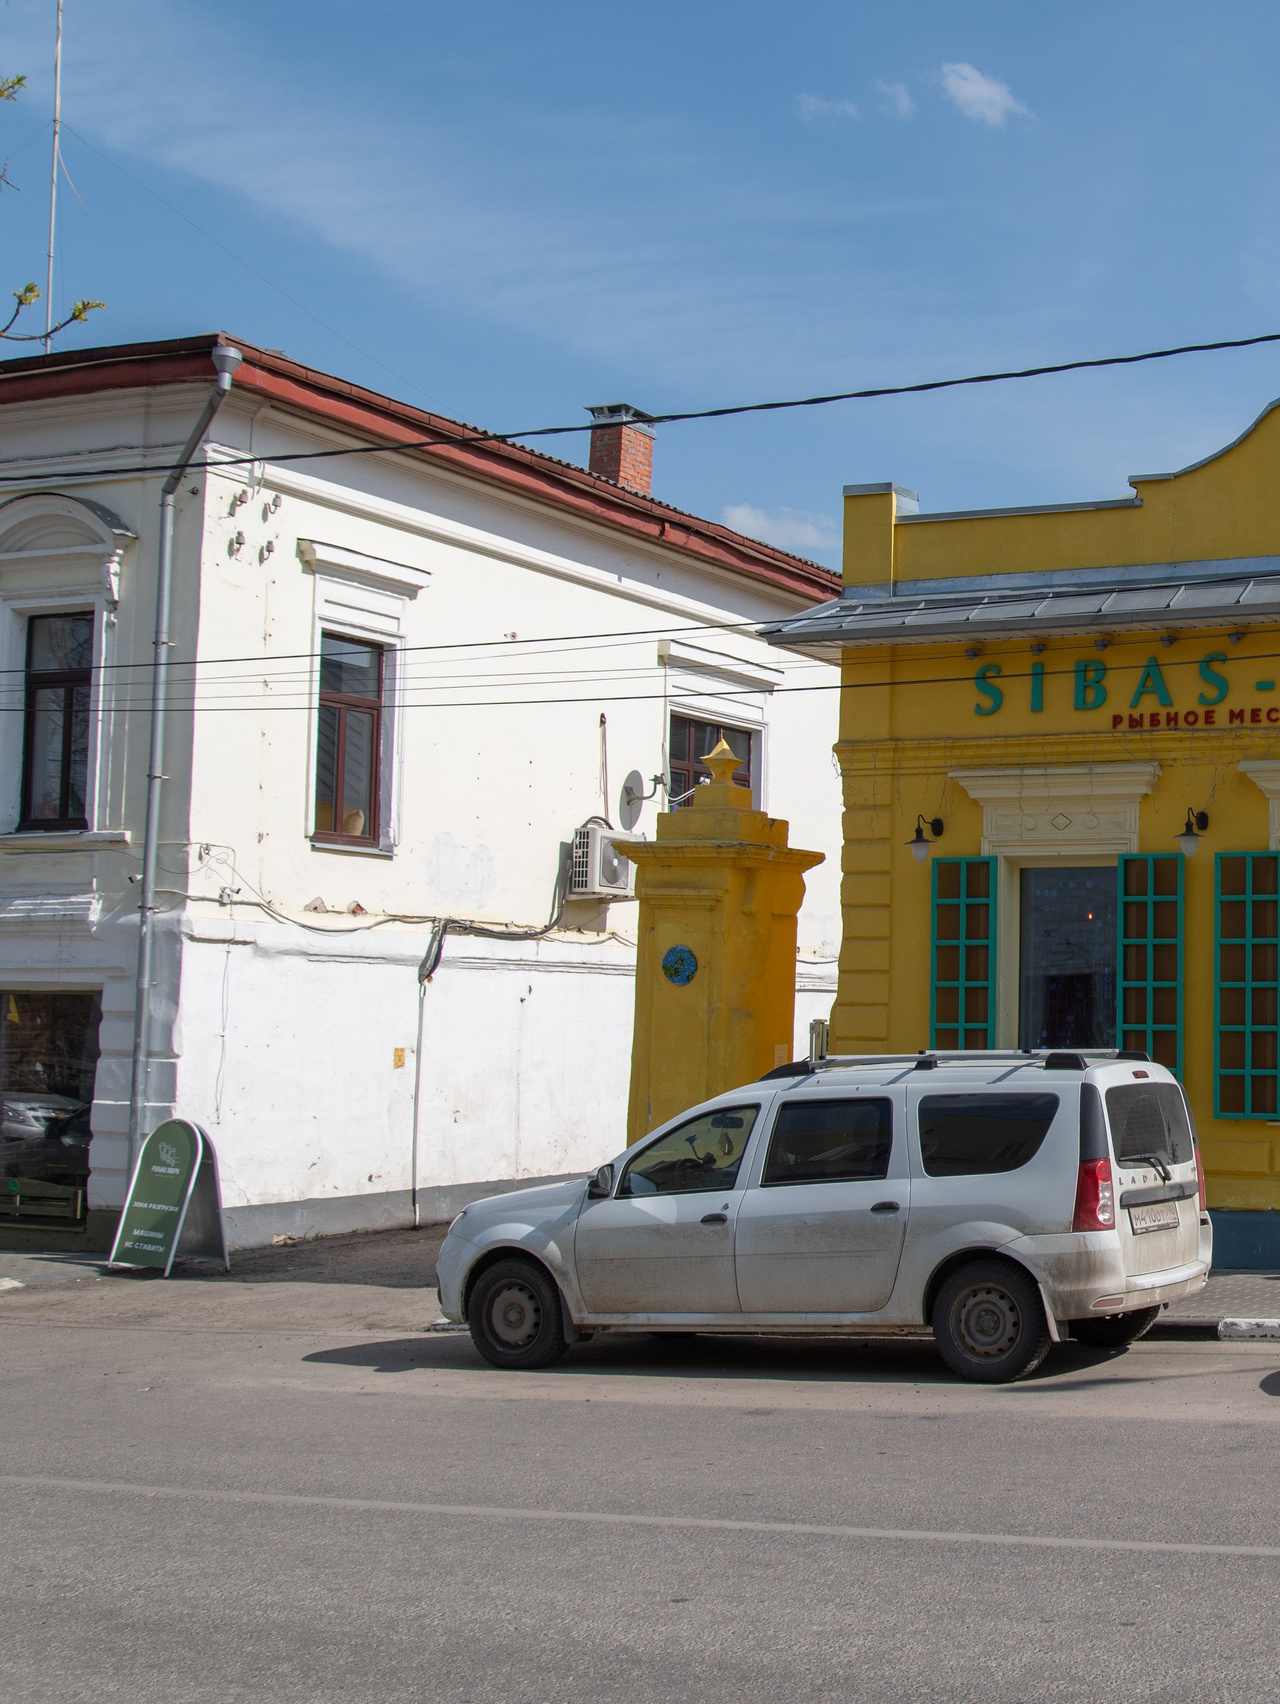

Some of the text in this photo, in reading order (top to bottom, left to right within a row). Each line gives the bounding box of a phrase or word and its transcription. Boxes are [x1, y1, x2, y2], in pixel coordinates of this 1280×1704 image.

[1111, 707, 1216, 730] РЫБНОЕ
[1119, 1174, 1158, 1186] LADA
[148, 1204, 179, 1212] РАЗГРУЗКИ
[133, 1229, 164, 1238] МАШИНЫ
